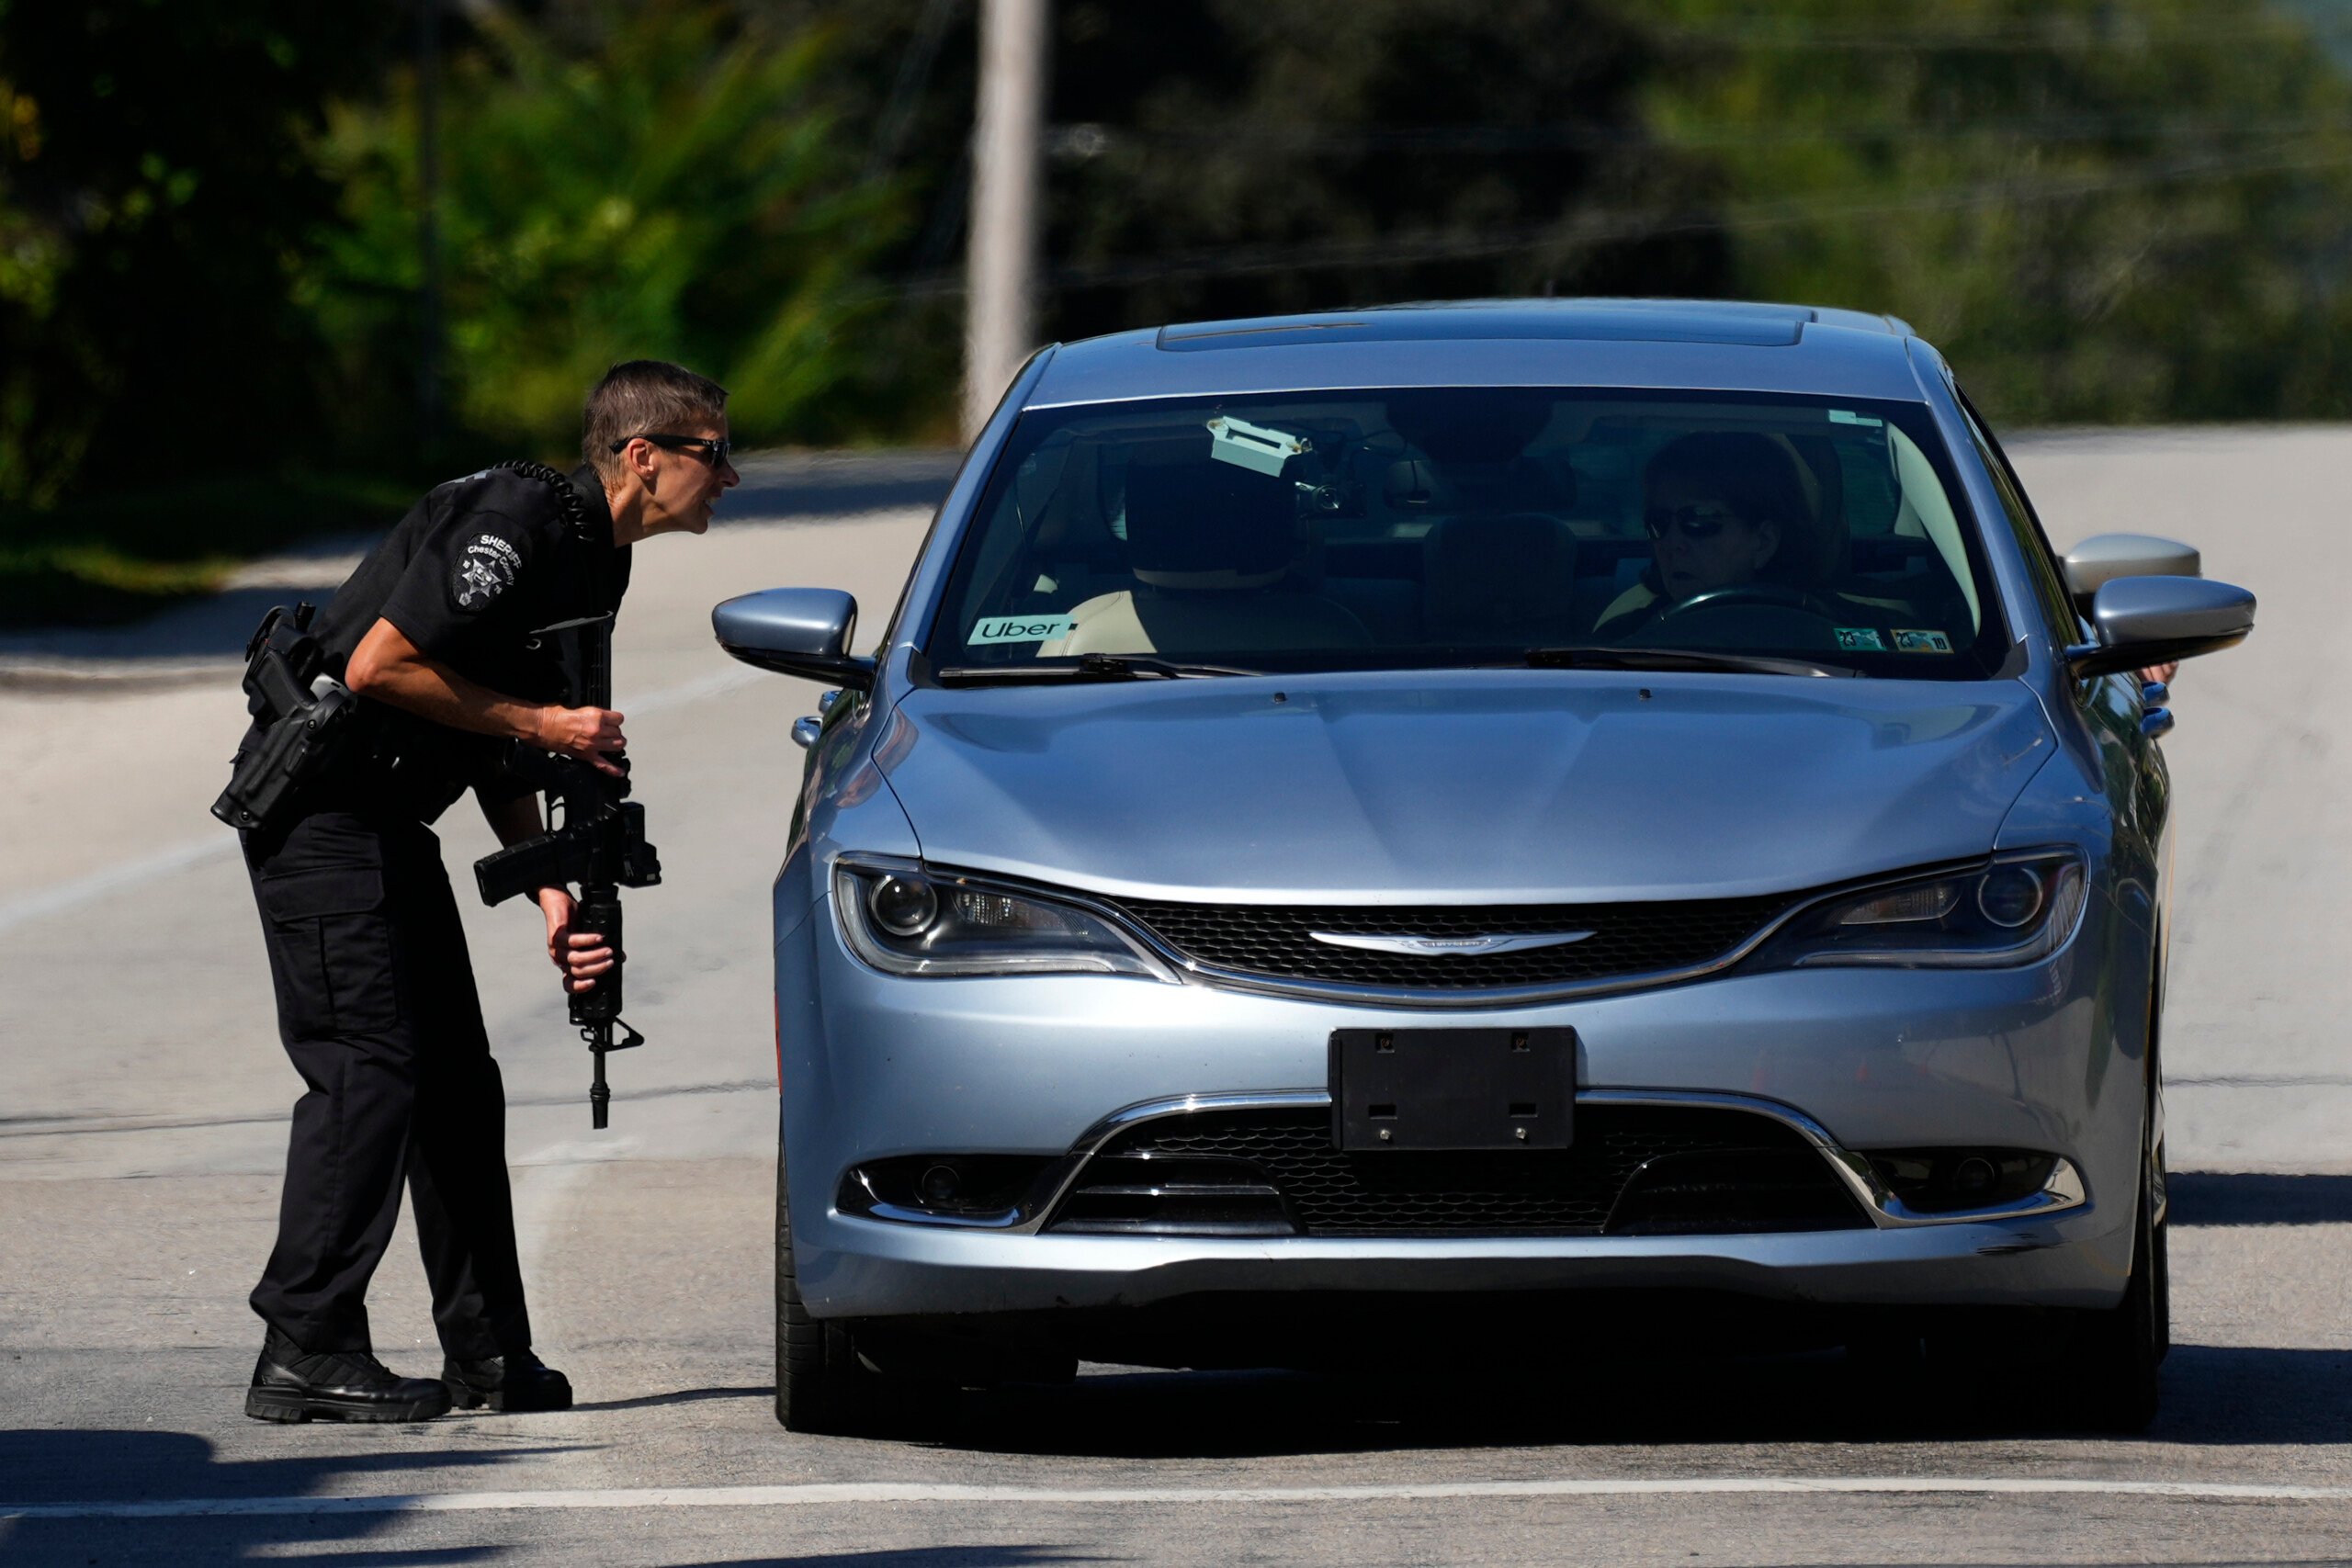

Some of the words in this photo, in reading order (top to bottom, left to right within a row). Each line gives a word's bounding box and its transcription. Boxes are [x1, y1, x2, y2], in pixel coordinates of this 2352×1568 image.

[467, 545, 502, 559] Chester
[499, 556, 515, 586] County
[480, 535, 523, 570] SHERIFF
[981, 622, 1060, 638] Uber
